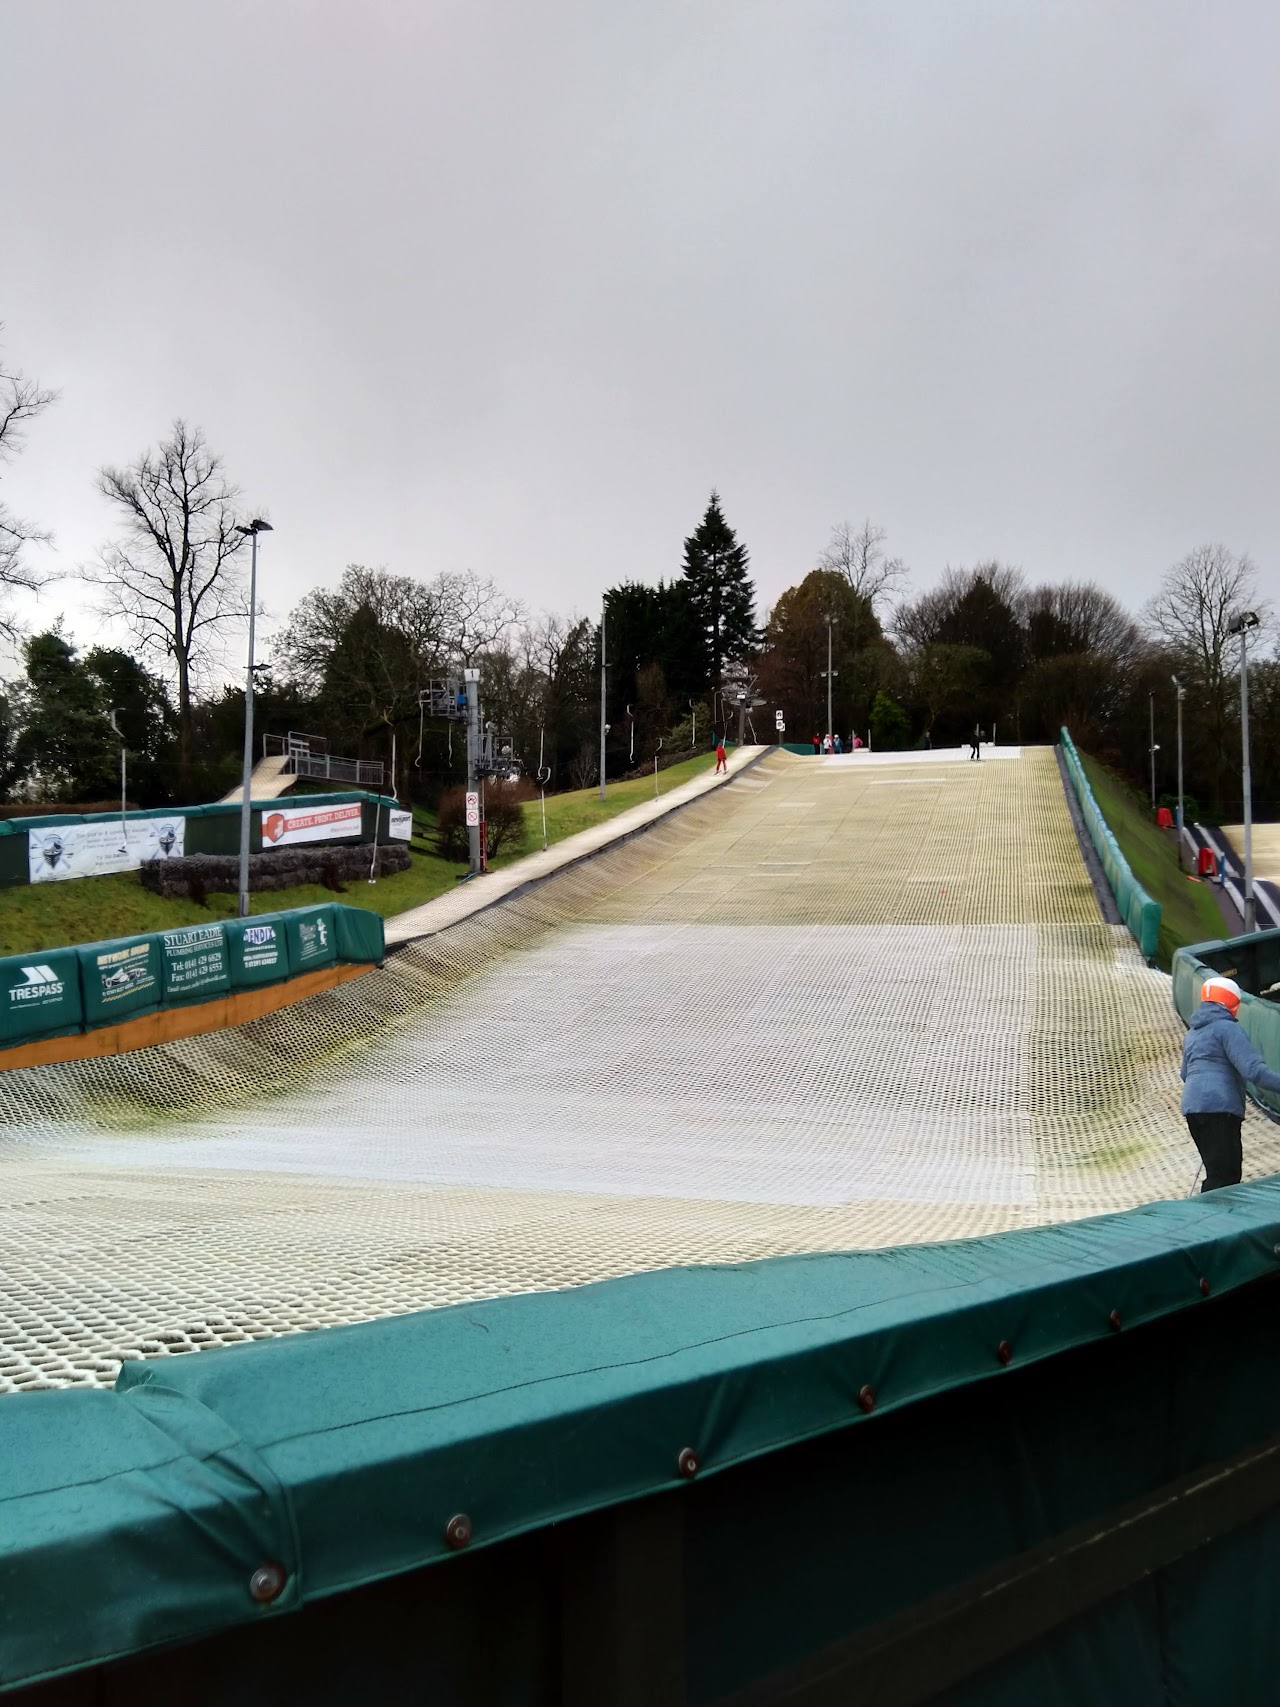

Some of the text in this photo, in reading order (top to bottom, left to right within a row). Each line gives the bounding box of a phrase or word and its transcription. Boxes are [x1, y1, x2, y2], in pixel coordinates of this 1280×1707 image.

[287, 808, 360, 829] CREATE. PRINT. DELIVER.
[164, 927, 222, 946] STUART EADIE
[166, 947, 193, 957] PLUMBING
[194, 942, 214, 952] SERVICES
[171, 961, 184, 971] Tel:
[184, 958, 197, 970] 0141
[198, 955, 207, 965] 429
[171, 973, 185, 982] Fax:
[185, 969, 198, 980] 0141
[199, 966, 208, 975] 429
[8, 983, 63, 1001] TRESPASS
